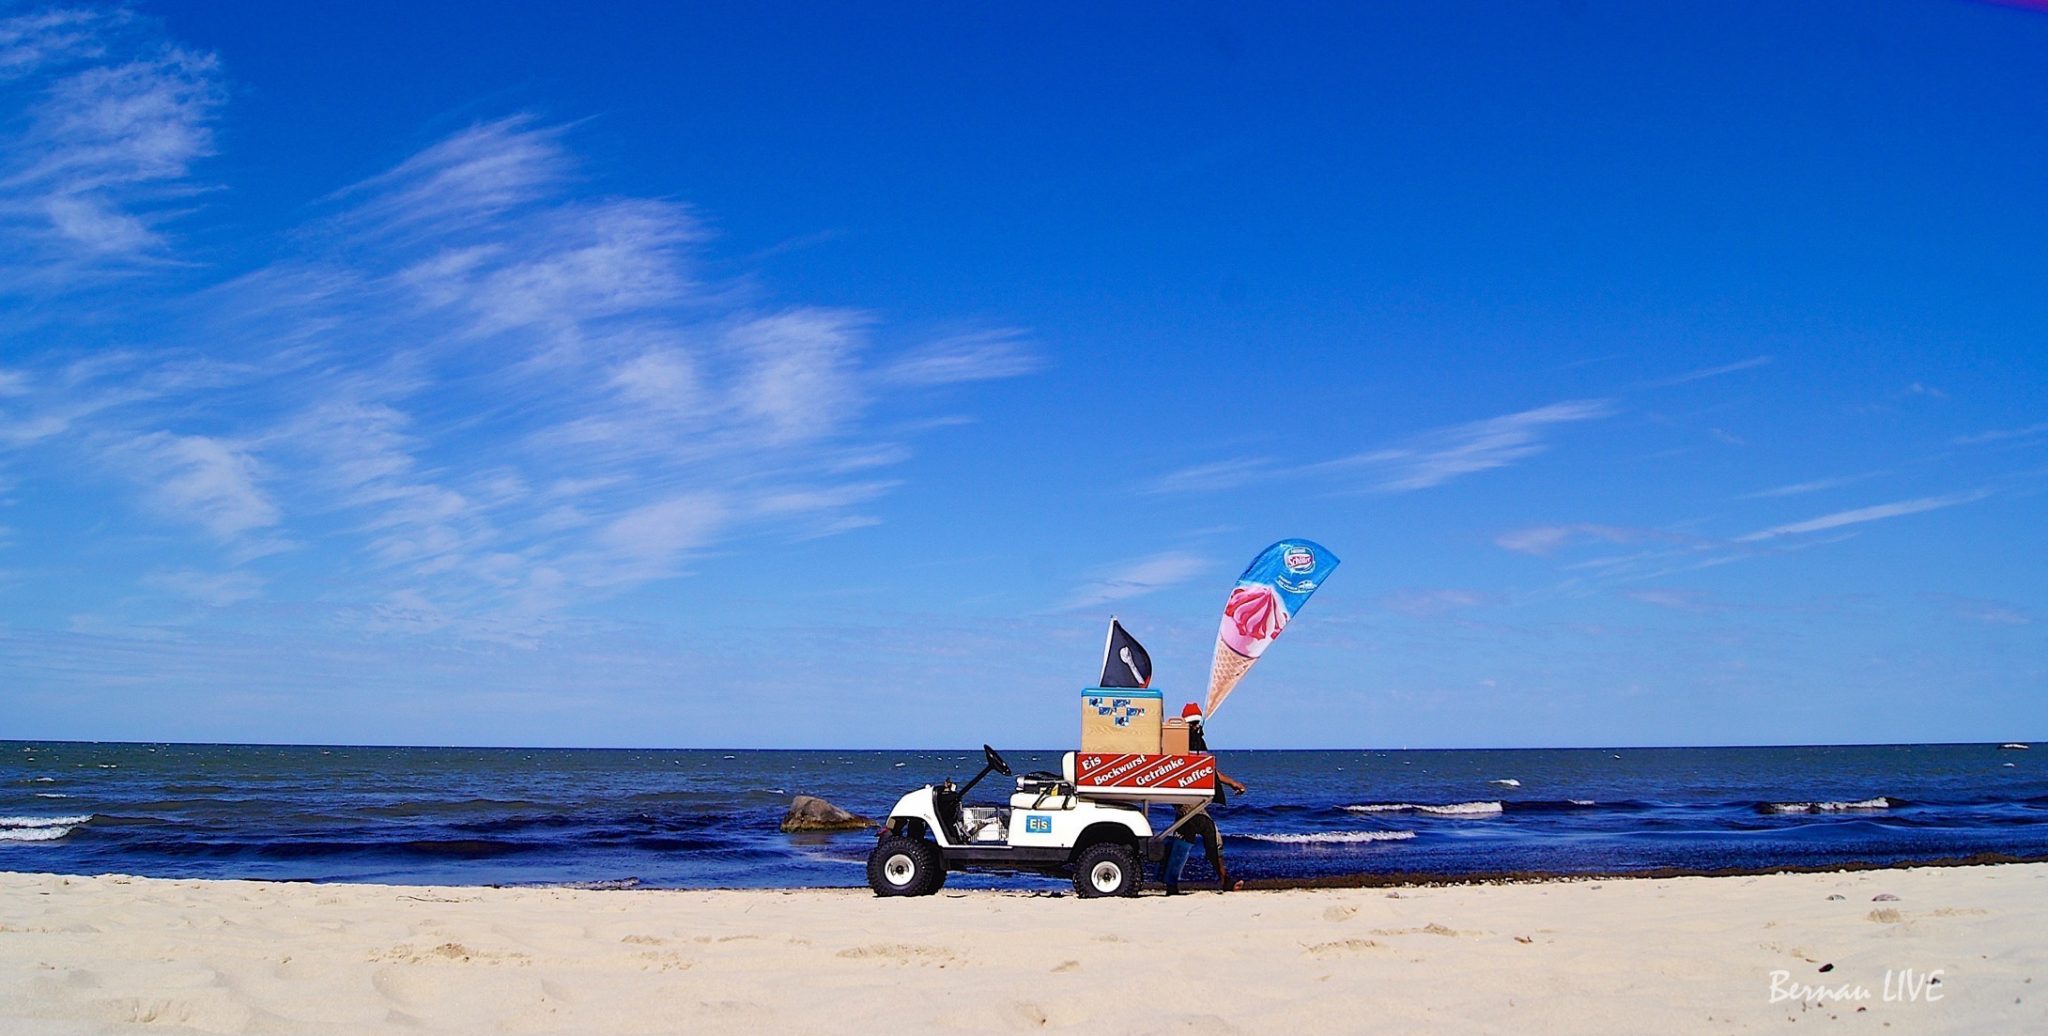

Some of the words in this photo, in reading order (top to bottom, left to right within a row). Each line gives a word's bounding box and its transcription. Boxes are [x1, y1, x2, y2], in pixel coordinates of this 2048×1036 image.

[1081, 755, 1102, 771] Eis
[1093, 754, 1147, 785] Bockwurst
[1136, 758, 1184, 786] Getränke
[1178, 767, 1213, 788] Kaffee
[1030, 818, 1048, 830] Eis
